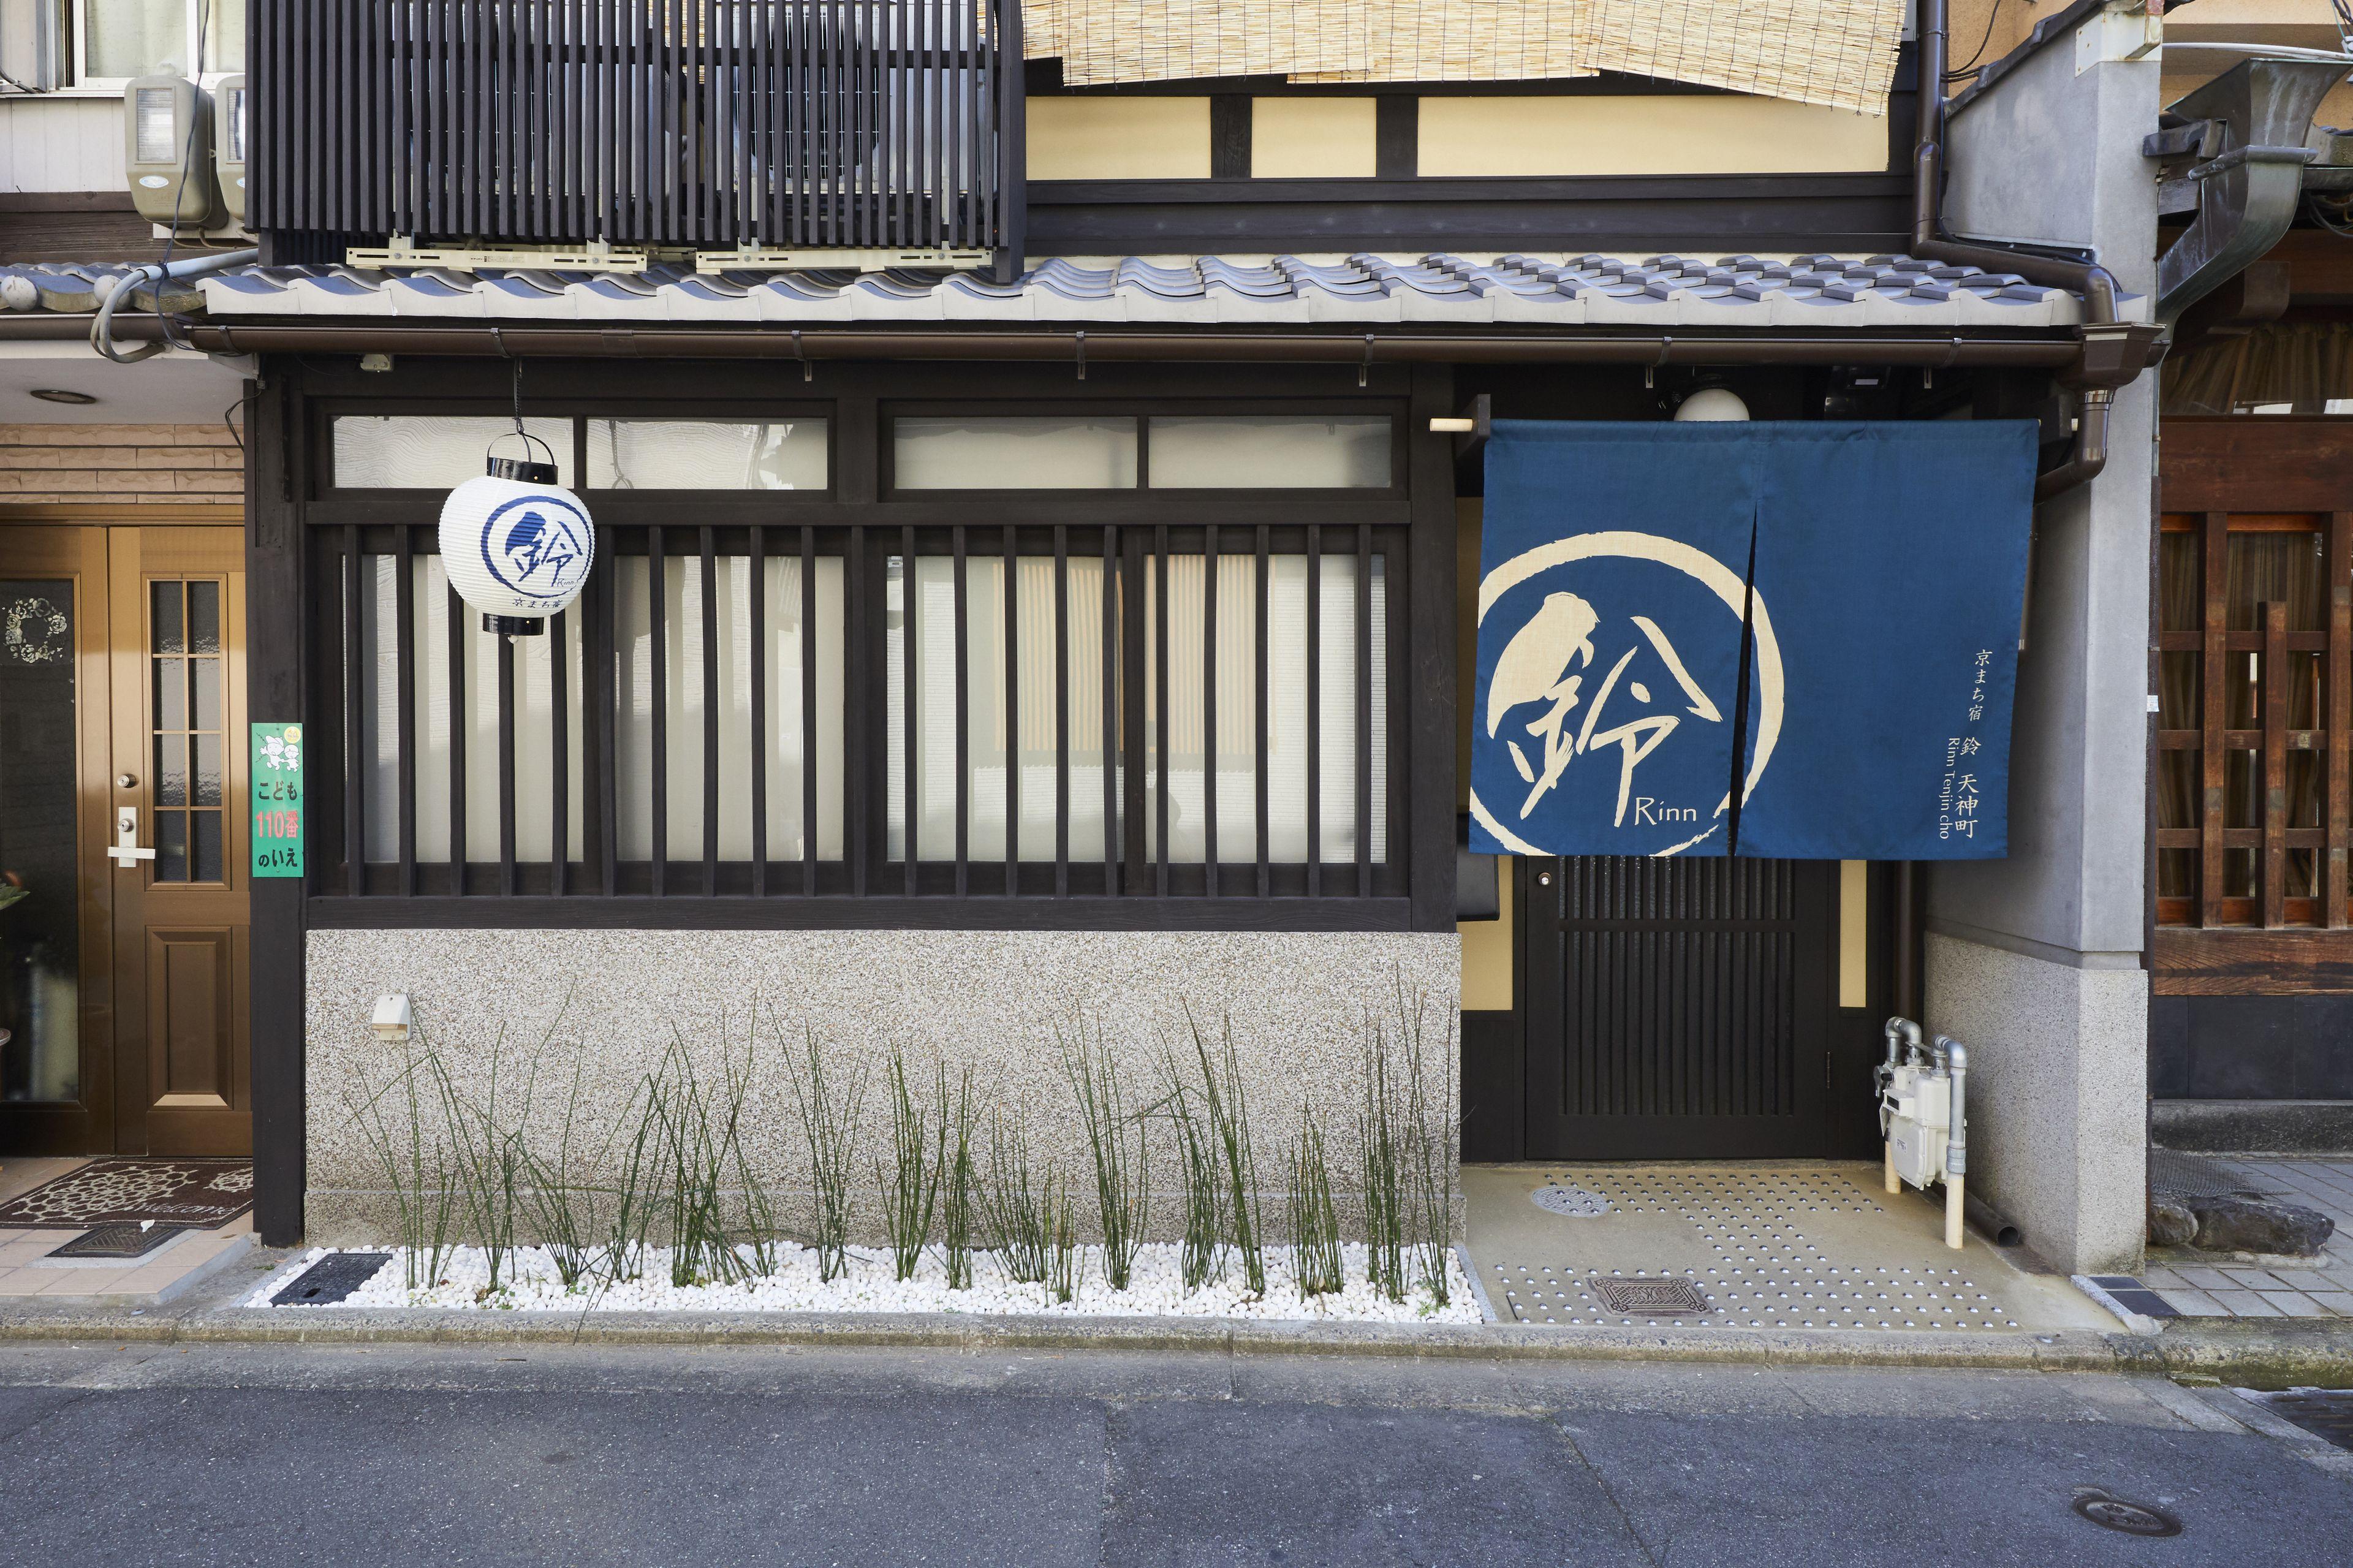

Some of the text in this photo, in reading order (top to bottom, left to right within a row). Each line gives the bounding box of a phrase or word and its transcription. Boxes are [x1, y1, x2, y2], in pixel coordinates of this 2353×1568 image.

[557, 578, 574, 587] Rinn
[512, 597, 563, 608] 京まち宿
[1954, 650, 1993, 839] 京まち宿 鈴 天神町
[258, 780, 298, 801] こども
[1939, 738, 1960, 839] Rinn Tenjin cho
[256, 809, 300, 839] 110番
[1634, 797, 1697, 826] Rinn
[258, 847, 298, 868] のいえ
